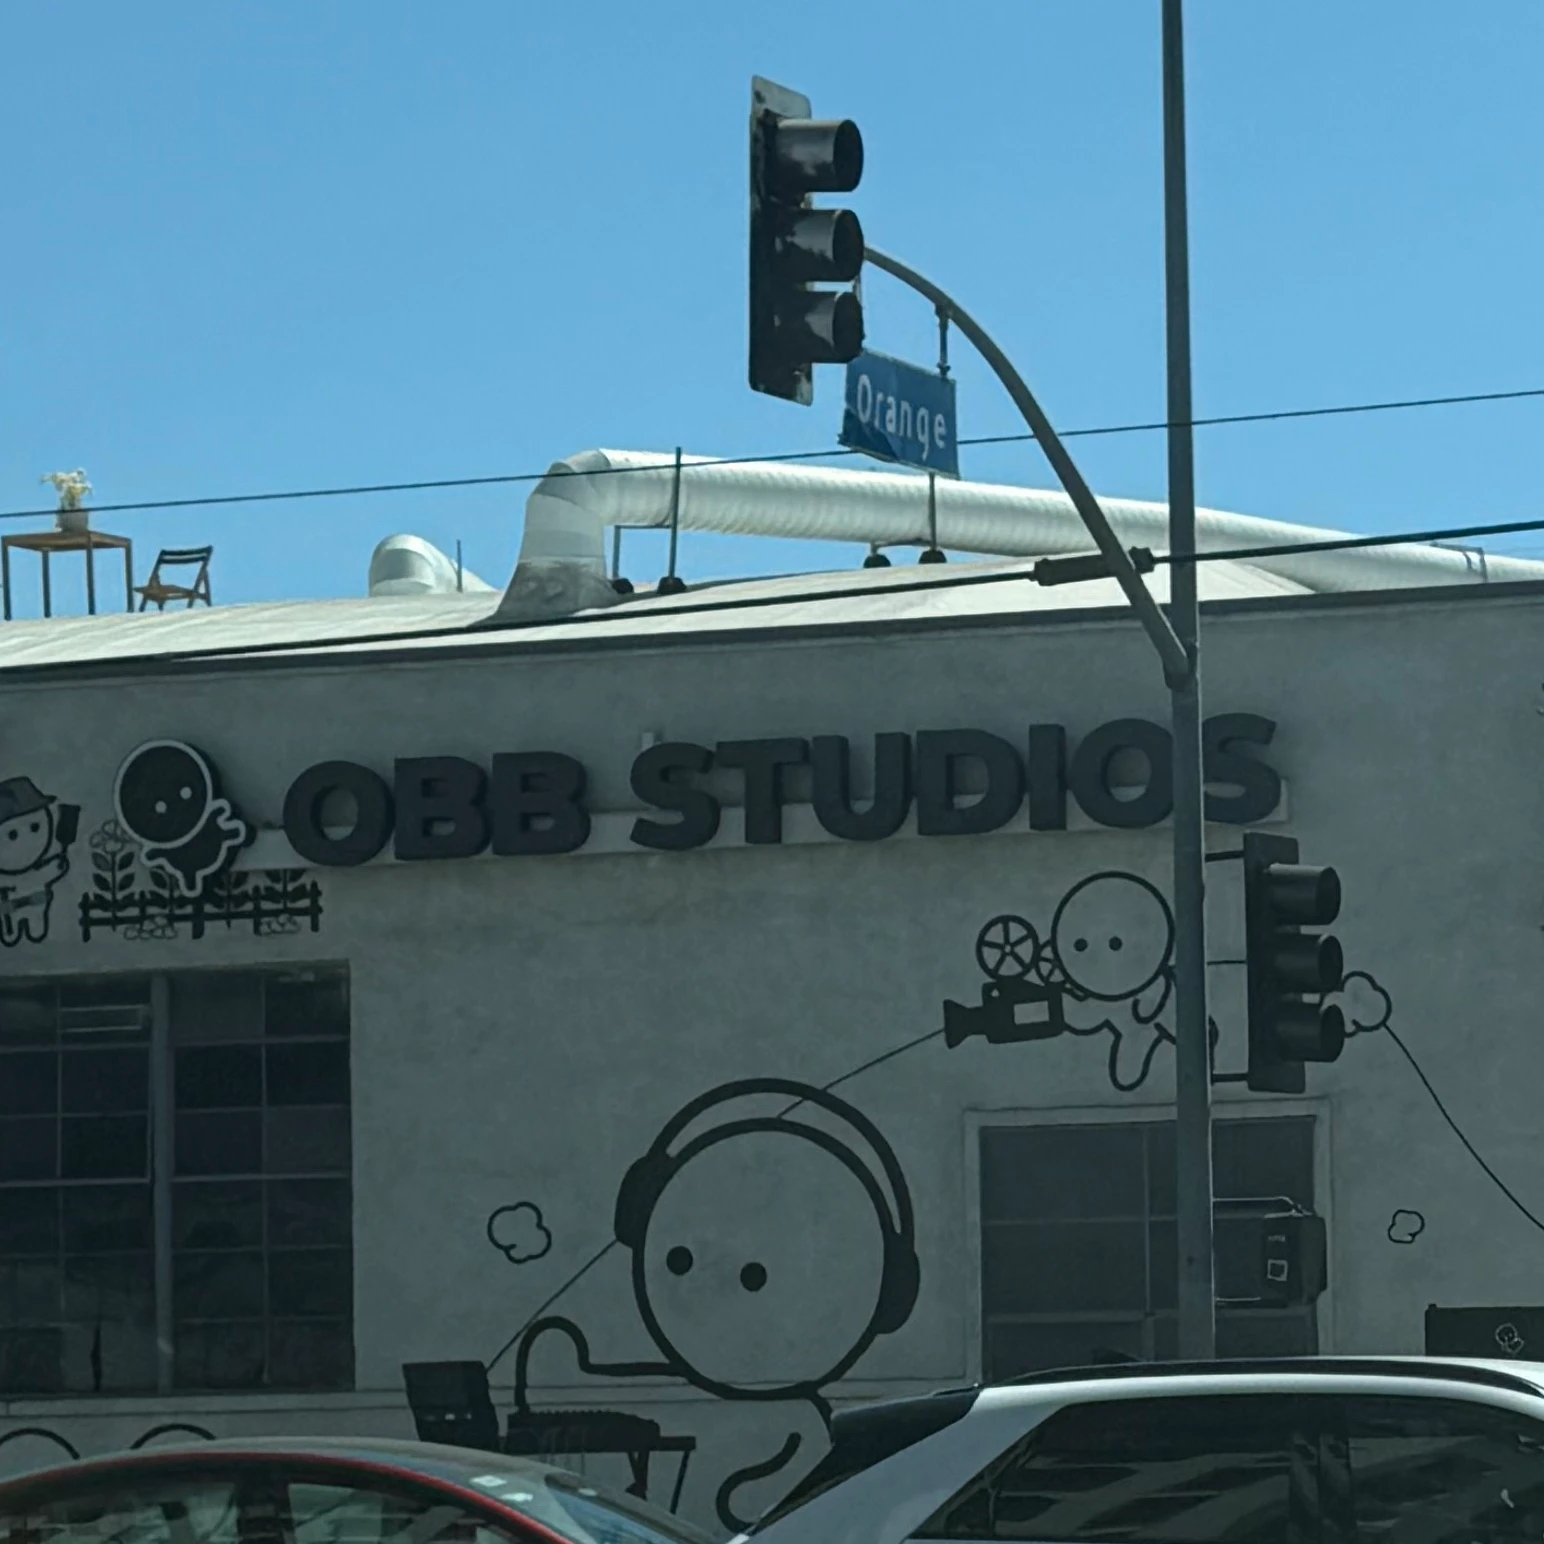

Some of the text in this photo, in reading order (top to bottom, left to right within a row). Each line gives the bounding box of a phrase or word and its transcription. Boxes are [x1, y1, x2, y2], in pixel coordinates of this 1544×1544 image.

[857, 374, 947, 461] Orange
[282, 711, 1283, 867] OBB STUDIOS
